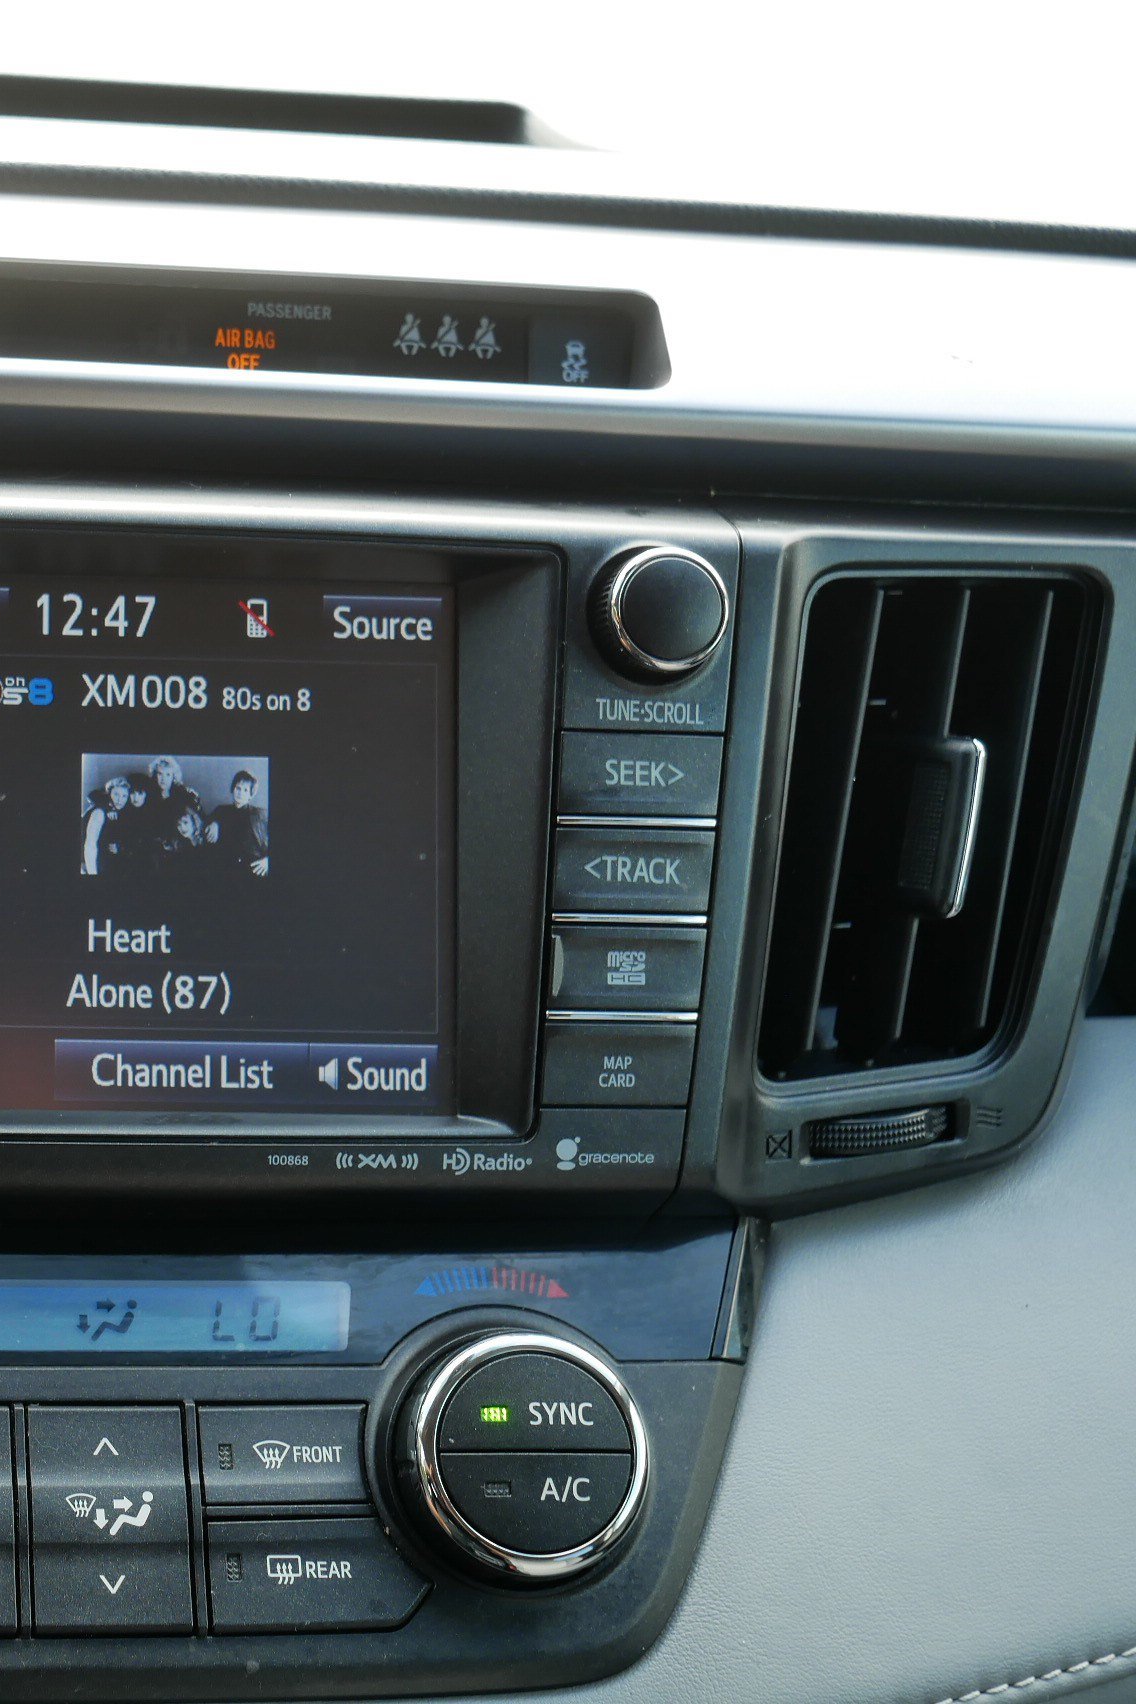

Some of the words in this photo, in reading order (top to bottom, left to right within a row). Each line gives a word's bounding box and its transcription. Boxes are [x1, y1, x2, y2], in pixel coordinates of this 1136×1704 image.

[247, 301, 332, 321] PASSENGER
[215, 328, 241, 347] AIR
[244, 329, 276, 349] BAG
[227, 354, 261, 370] OFF
[563, 371, 588, 383] OFF
[36, 593, 157, 638] 12:47
[332, 606, 433, 641] Source
[222, 687, 261, 711] 80s
[267, 693, 291, 712] on
[297, 690, 311, 712] 8
[87, 918, 171, 955] Heart
[66, 974, 154, 1010] Alone
[161, 971, 232, 1015] (87)
[91, 1053, 211, 1090] Channel
[220, 1055, 274, 1090] List
[346, 1056, 427, 1092] Sound
[603, 1056, 633, 1071] MAP
[599, 1073, 635, 1088] CARD
[267, 1155, 309, 1166] 100868
[578, 1149, 655, 1165] gracenote
[528, 1401, 595, 1427] SYNC
[292, 1446, 343, 1463] FRONT
[539, 1477, 591, 1503] A/C
[305, 1561, 352, 1579] REAR
